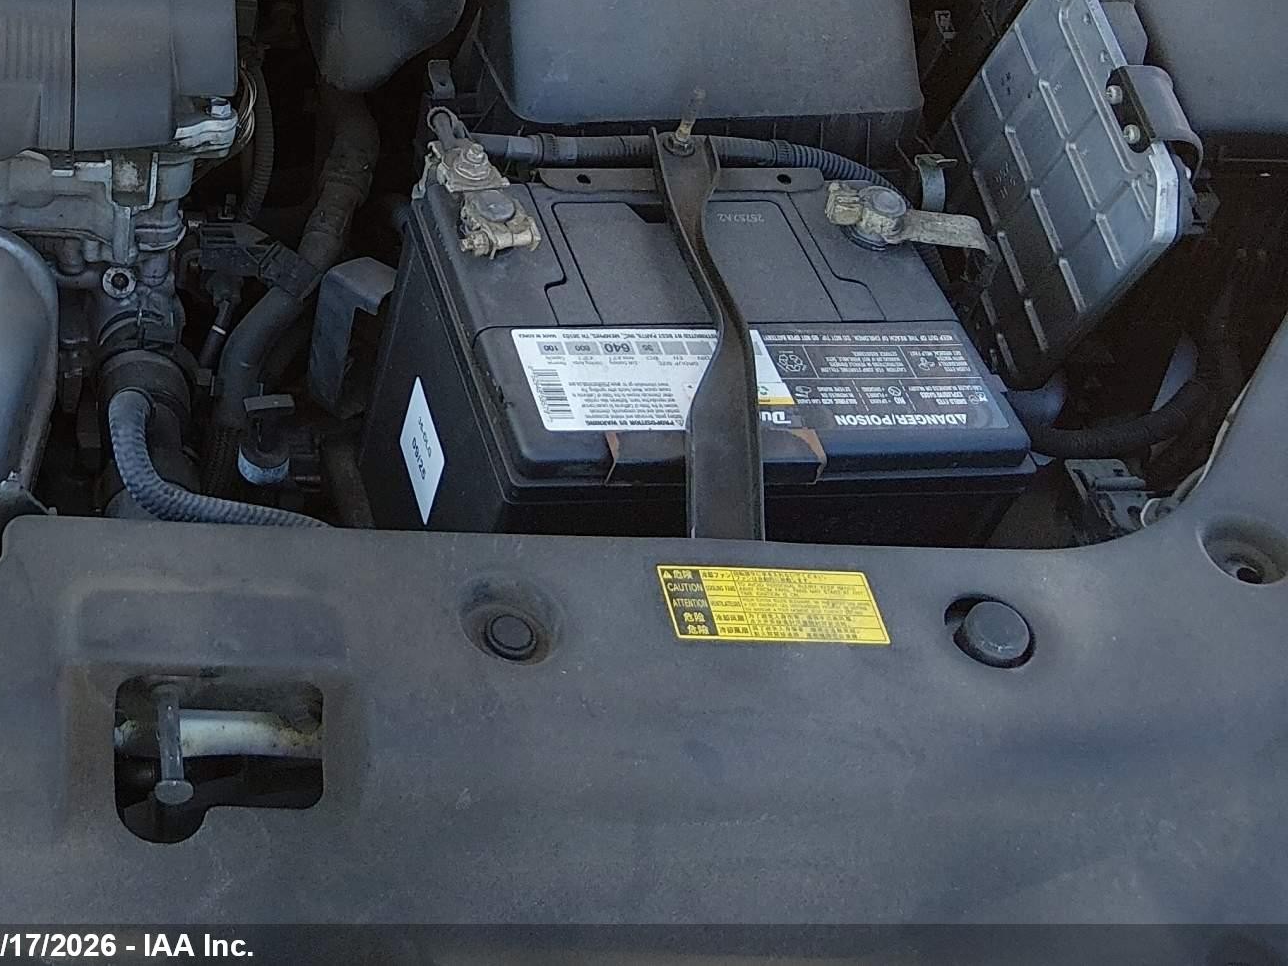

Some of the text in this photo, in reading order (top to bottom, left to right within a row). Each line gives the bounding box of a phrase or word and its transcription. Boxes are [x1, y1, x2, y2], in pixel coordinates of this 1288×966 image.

[604, 342, 631, 353] 640
[834, 412, 956, 426] DANGER/POISON
[666, 582, 703, 592] CAUTION
[672, 598, 709, 608] ATTENTION
